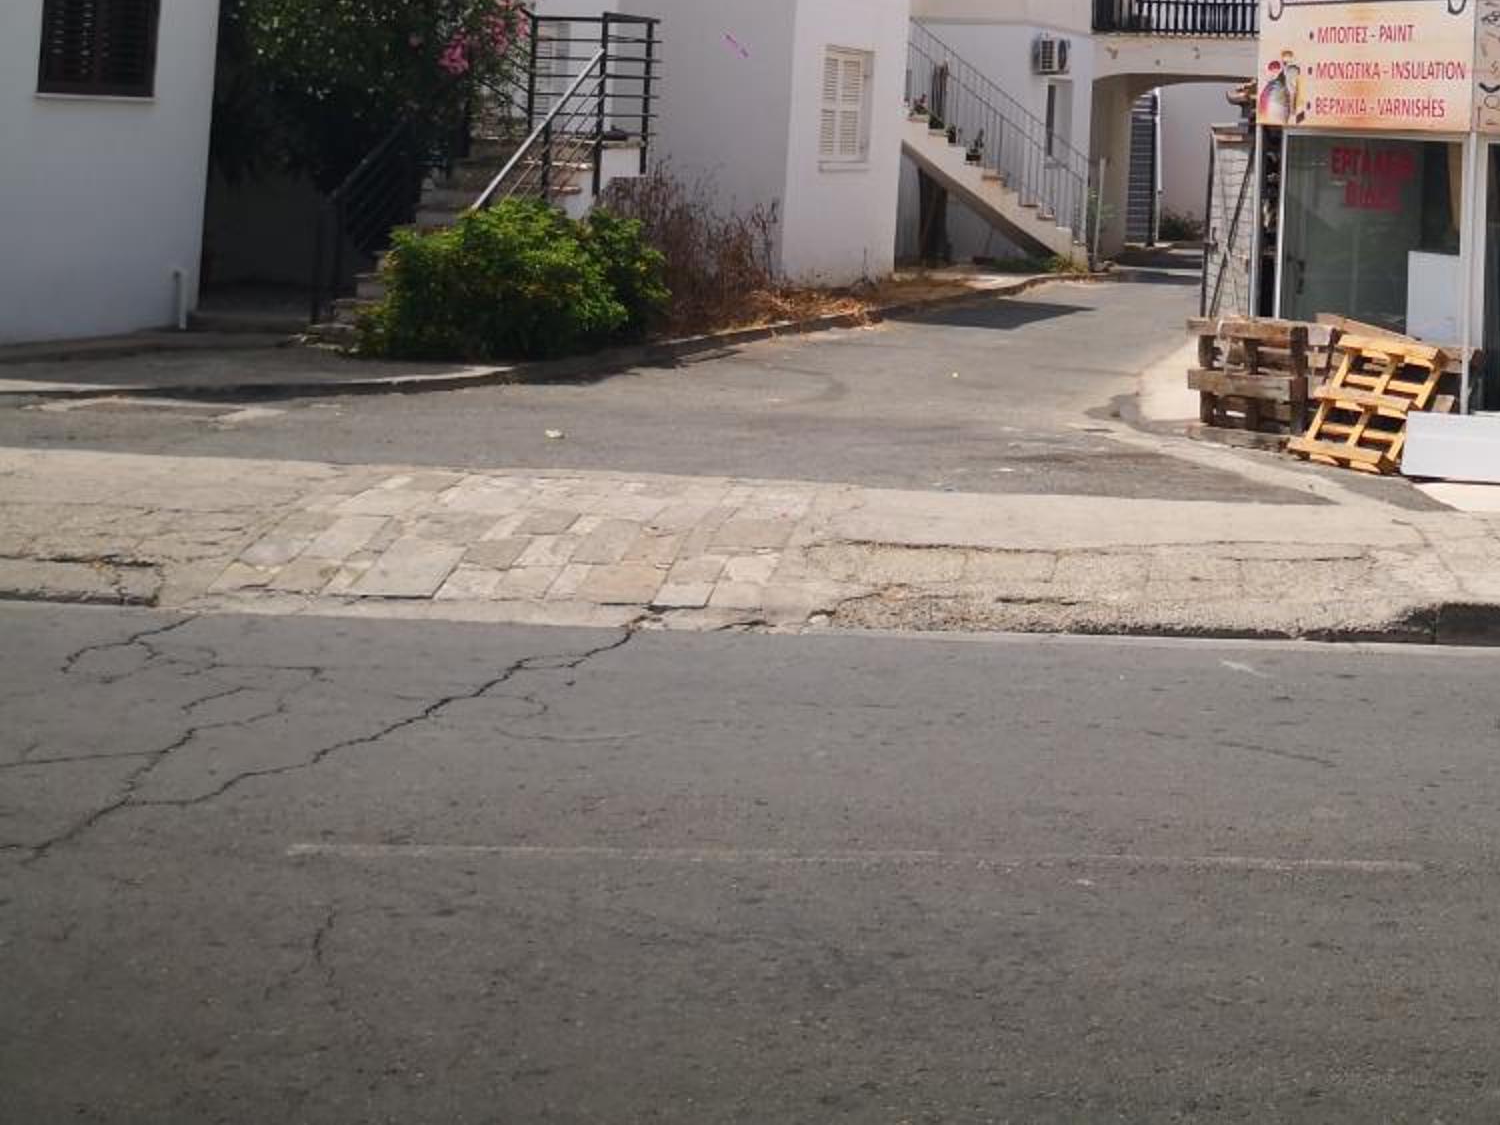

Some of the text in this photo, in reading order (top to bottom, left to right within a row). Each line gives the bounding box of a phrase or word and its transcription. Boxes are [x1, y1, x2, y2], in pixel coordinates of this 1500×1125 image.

[1379, 25, 1414, 42] PAINT
[1391, 61, 1465, 80] INSULATION
[1377, 97, 1444, 118] VARNISHES
